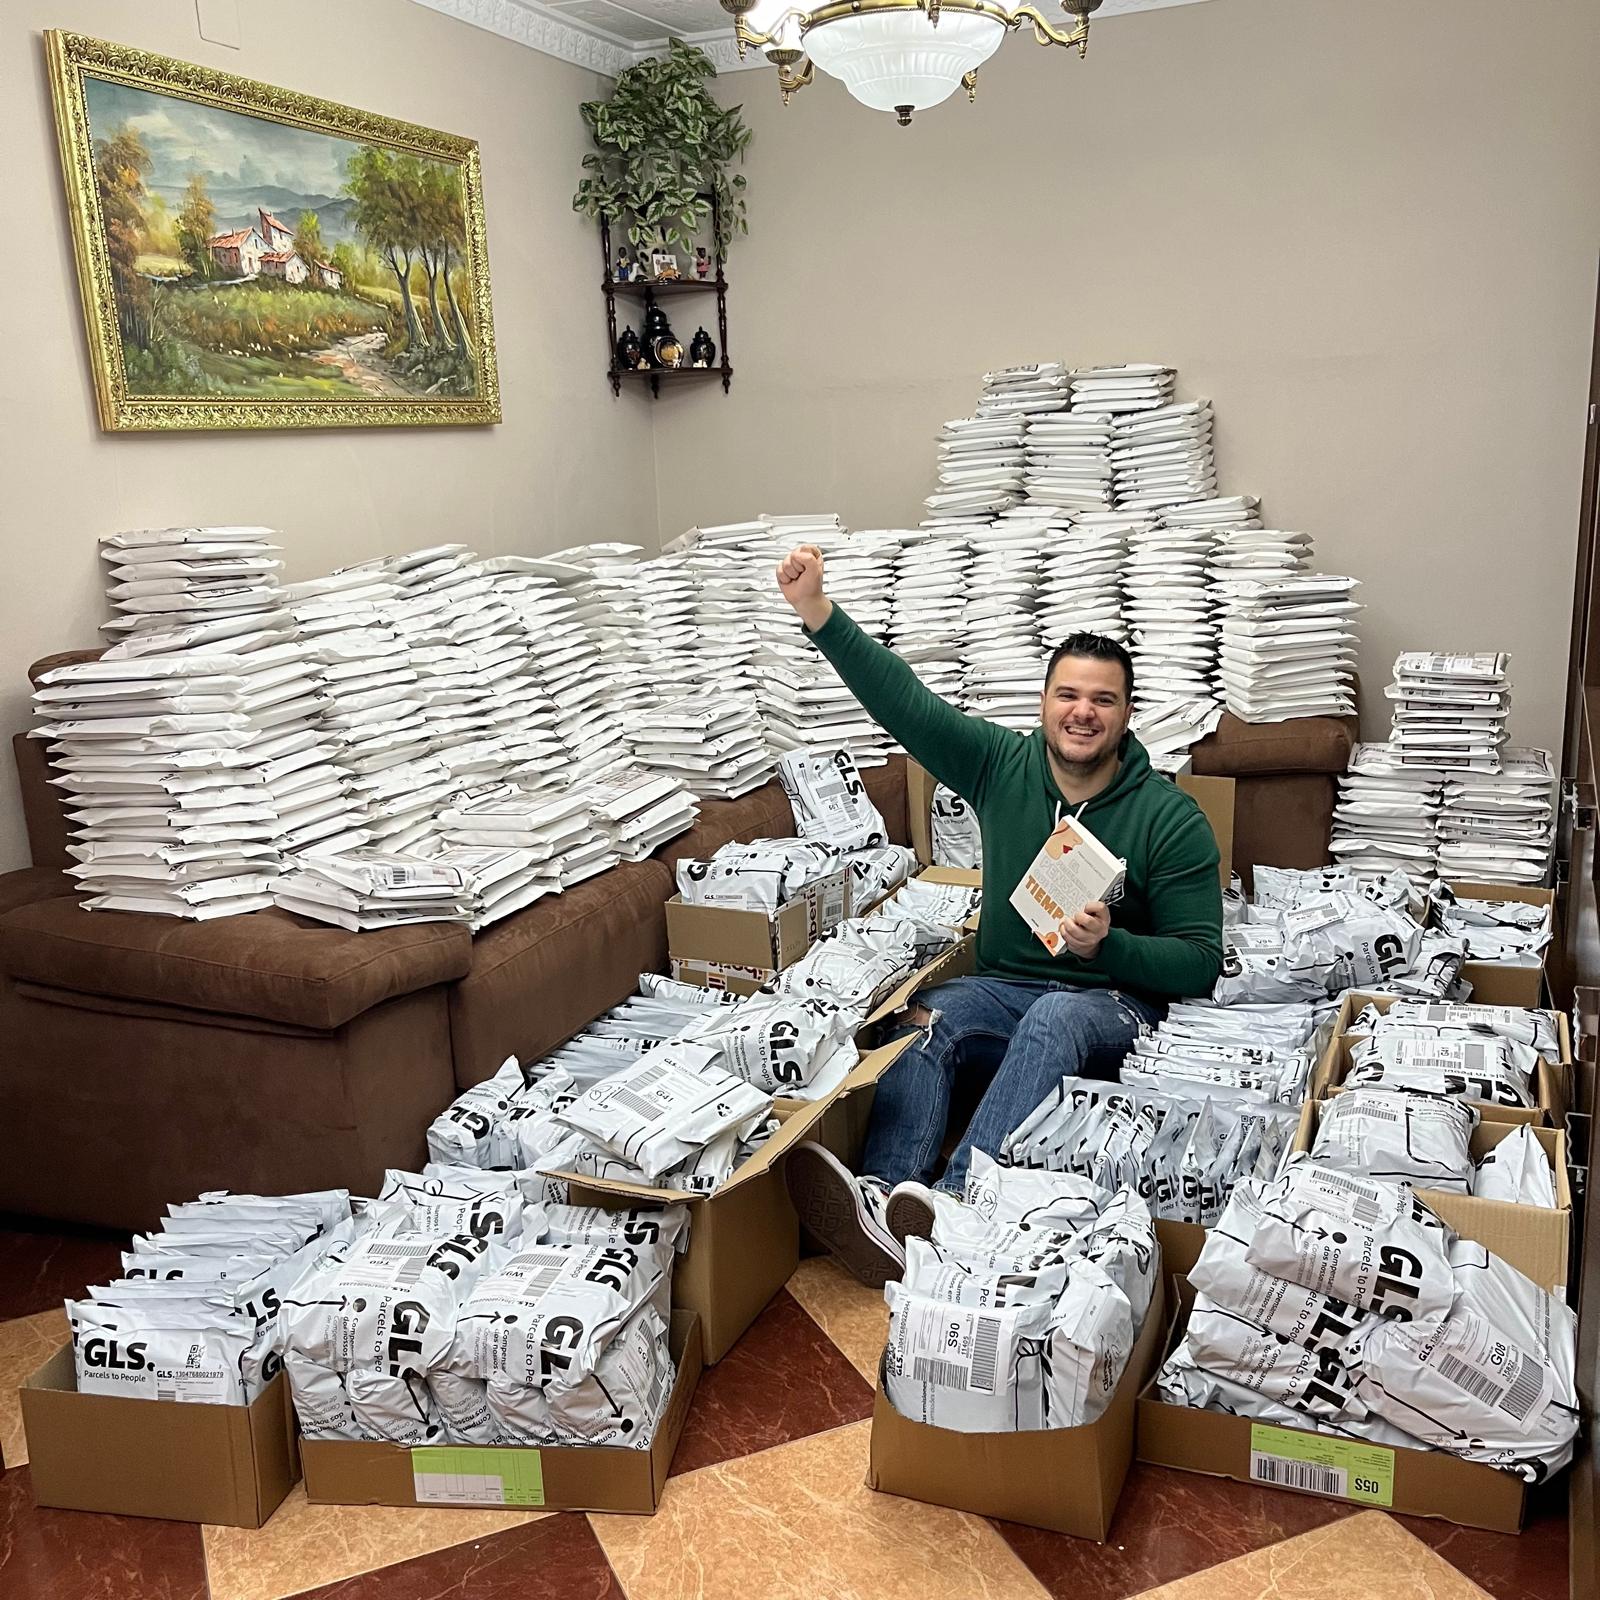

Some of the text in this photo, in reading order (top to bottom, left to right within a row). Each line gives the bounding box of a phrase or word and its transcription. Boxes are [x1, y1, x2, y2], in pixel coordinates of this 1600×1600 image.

[834, 750, 864, 804] GLS.
[935, 796, 965, 817] LS
[1024, 875, 1064, 920] TIEMP
[1374, 934, 1409, 982] GL
[770, 1020, 803, 1083] GLS
[758, 1058, 773, 1086] People
[450, 1106, 490, 1139] GL
[1200, 1182, 1221, 1211] GL
[1322, 1245, 1331, 1260] dos
[1360, 1235, 1375, 1273] Parcels
[1358, 1276, 1366, 1289] to
[1373, 1245, 1423, 1321] GLS
[374, 1296, 392, 1373] Parcels to Peo
[388, 1301, 430, 1380] GL
[526, 1314, 545, 1352] Parcels
[947, 1322, 960, 1347] S90
[1289, 1310, 1310, 1344] to Peop
[84, 1338, 155, 1373] GLS.
[526, 1355, 534, 1366] to
[541, 1315, 584, 1387] GL
[894, 1353, 904, 1375] GLS.
[1418, 1343, 1435, 1362] GLS.
[1490, 1342, 1507, 1366] G08
[84, 1370, 146, 1383] Parcels to People
[157, 1370, 175, 1378] GLS.
[1293, 1346, 1353, 1410] GL
